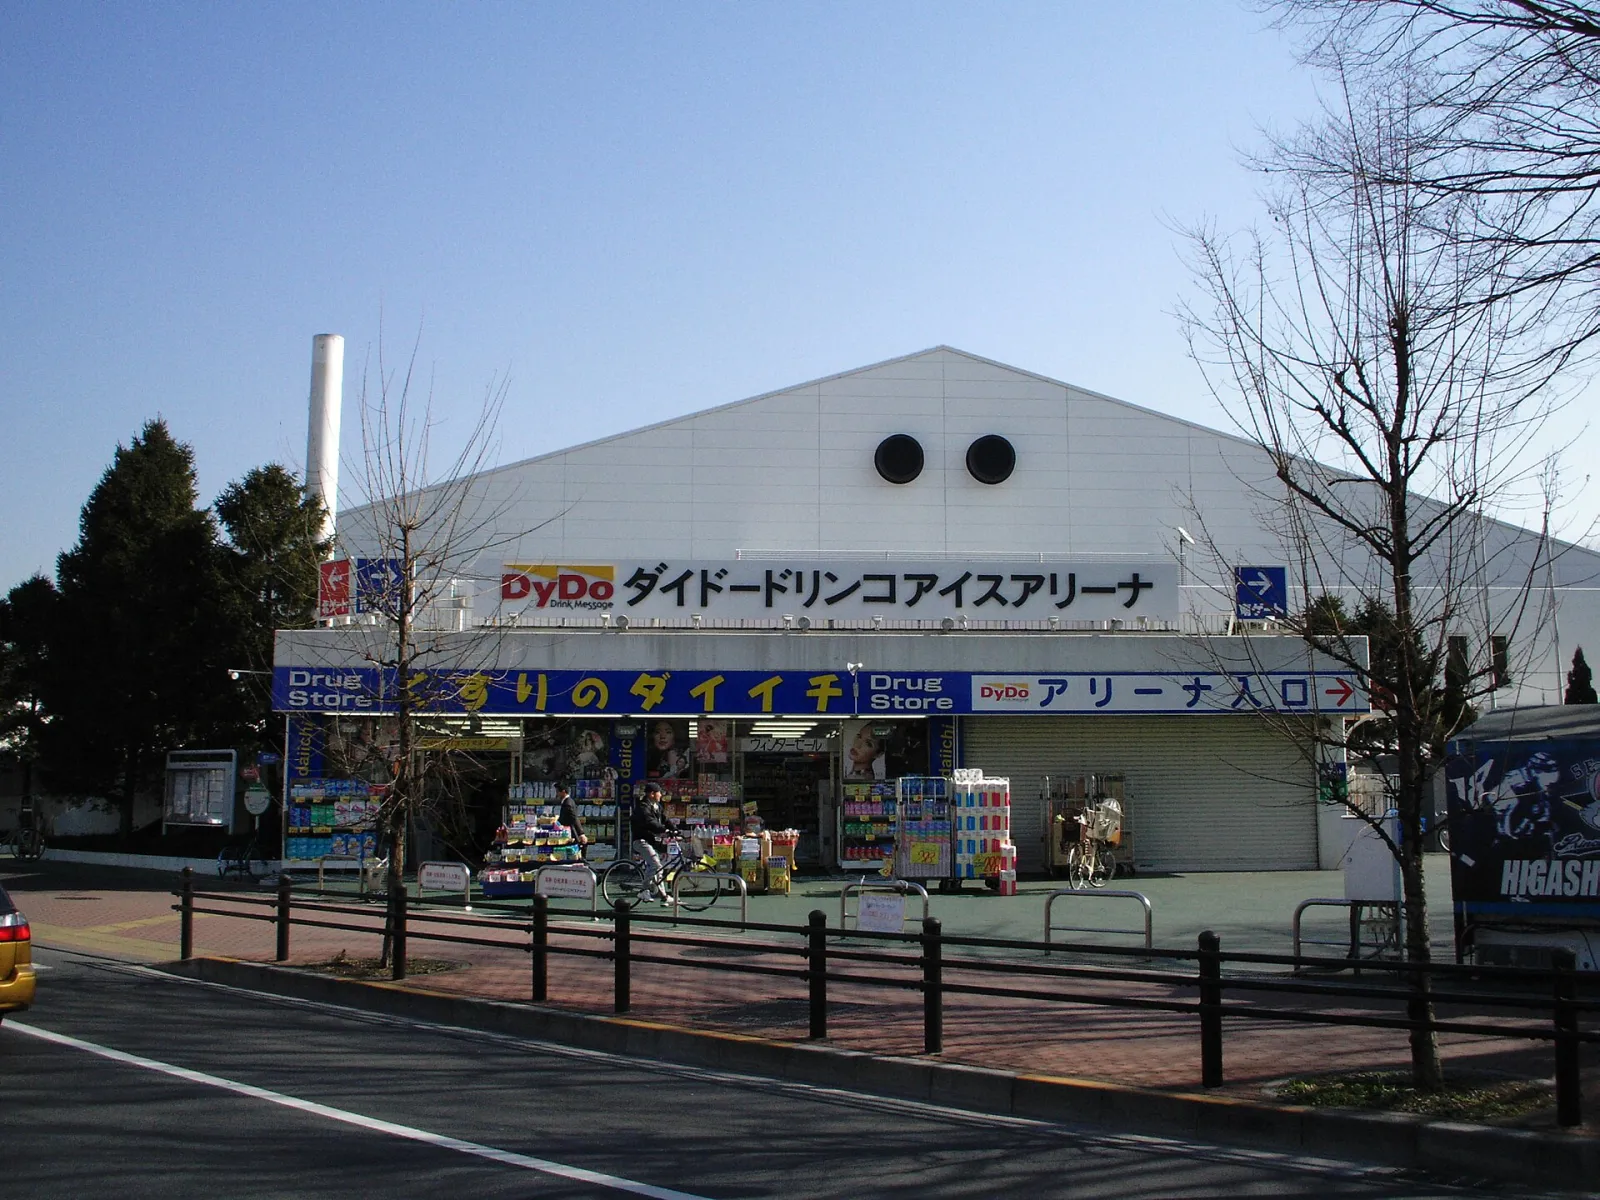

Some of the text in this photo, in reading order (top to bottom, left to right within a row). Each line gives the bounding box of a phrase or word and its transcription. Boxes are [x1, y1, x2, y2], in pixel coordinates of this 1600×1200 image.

[502, 574, 614, 608] DyDo
[623, 562, 1153, 609] ダイドードリンコアイスアリーナ
[550, 600, 614, 610] Drink Message
[289, 670, 363, 690] Drug
[870, 674, 943, 692] Drug
[289, 690, 372, 707] Store
[407, 672, 843, 712] くすりのダイイチ
[980, 686, 1029, 701] DyDo
[1038, 676, 1308, 708] アリーナ入口
[870, 693, 953, 710] Store
[750, 738, 823, 751] ウィンターセール
